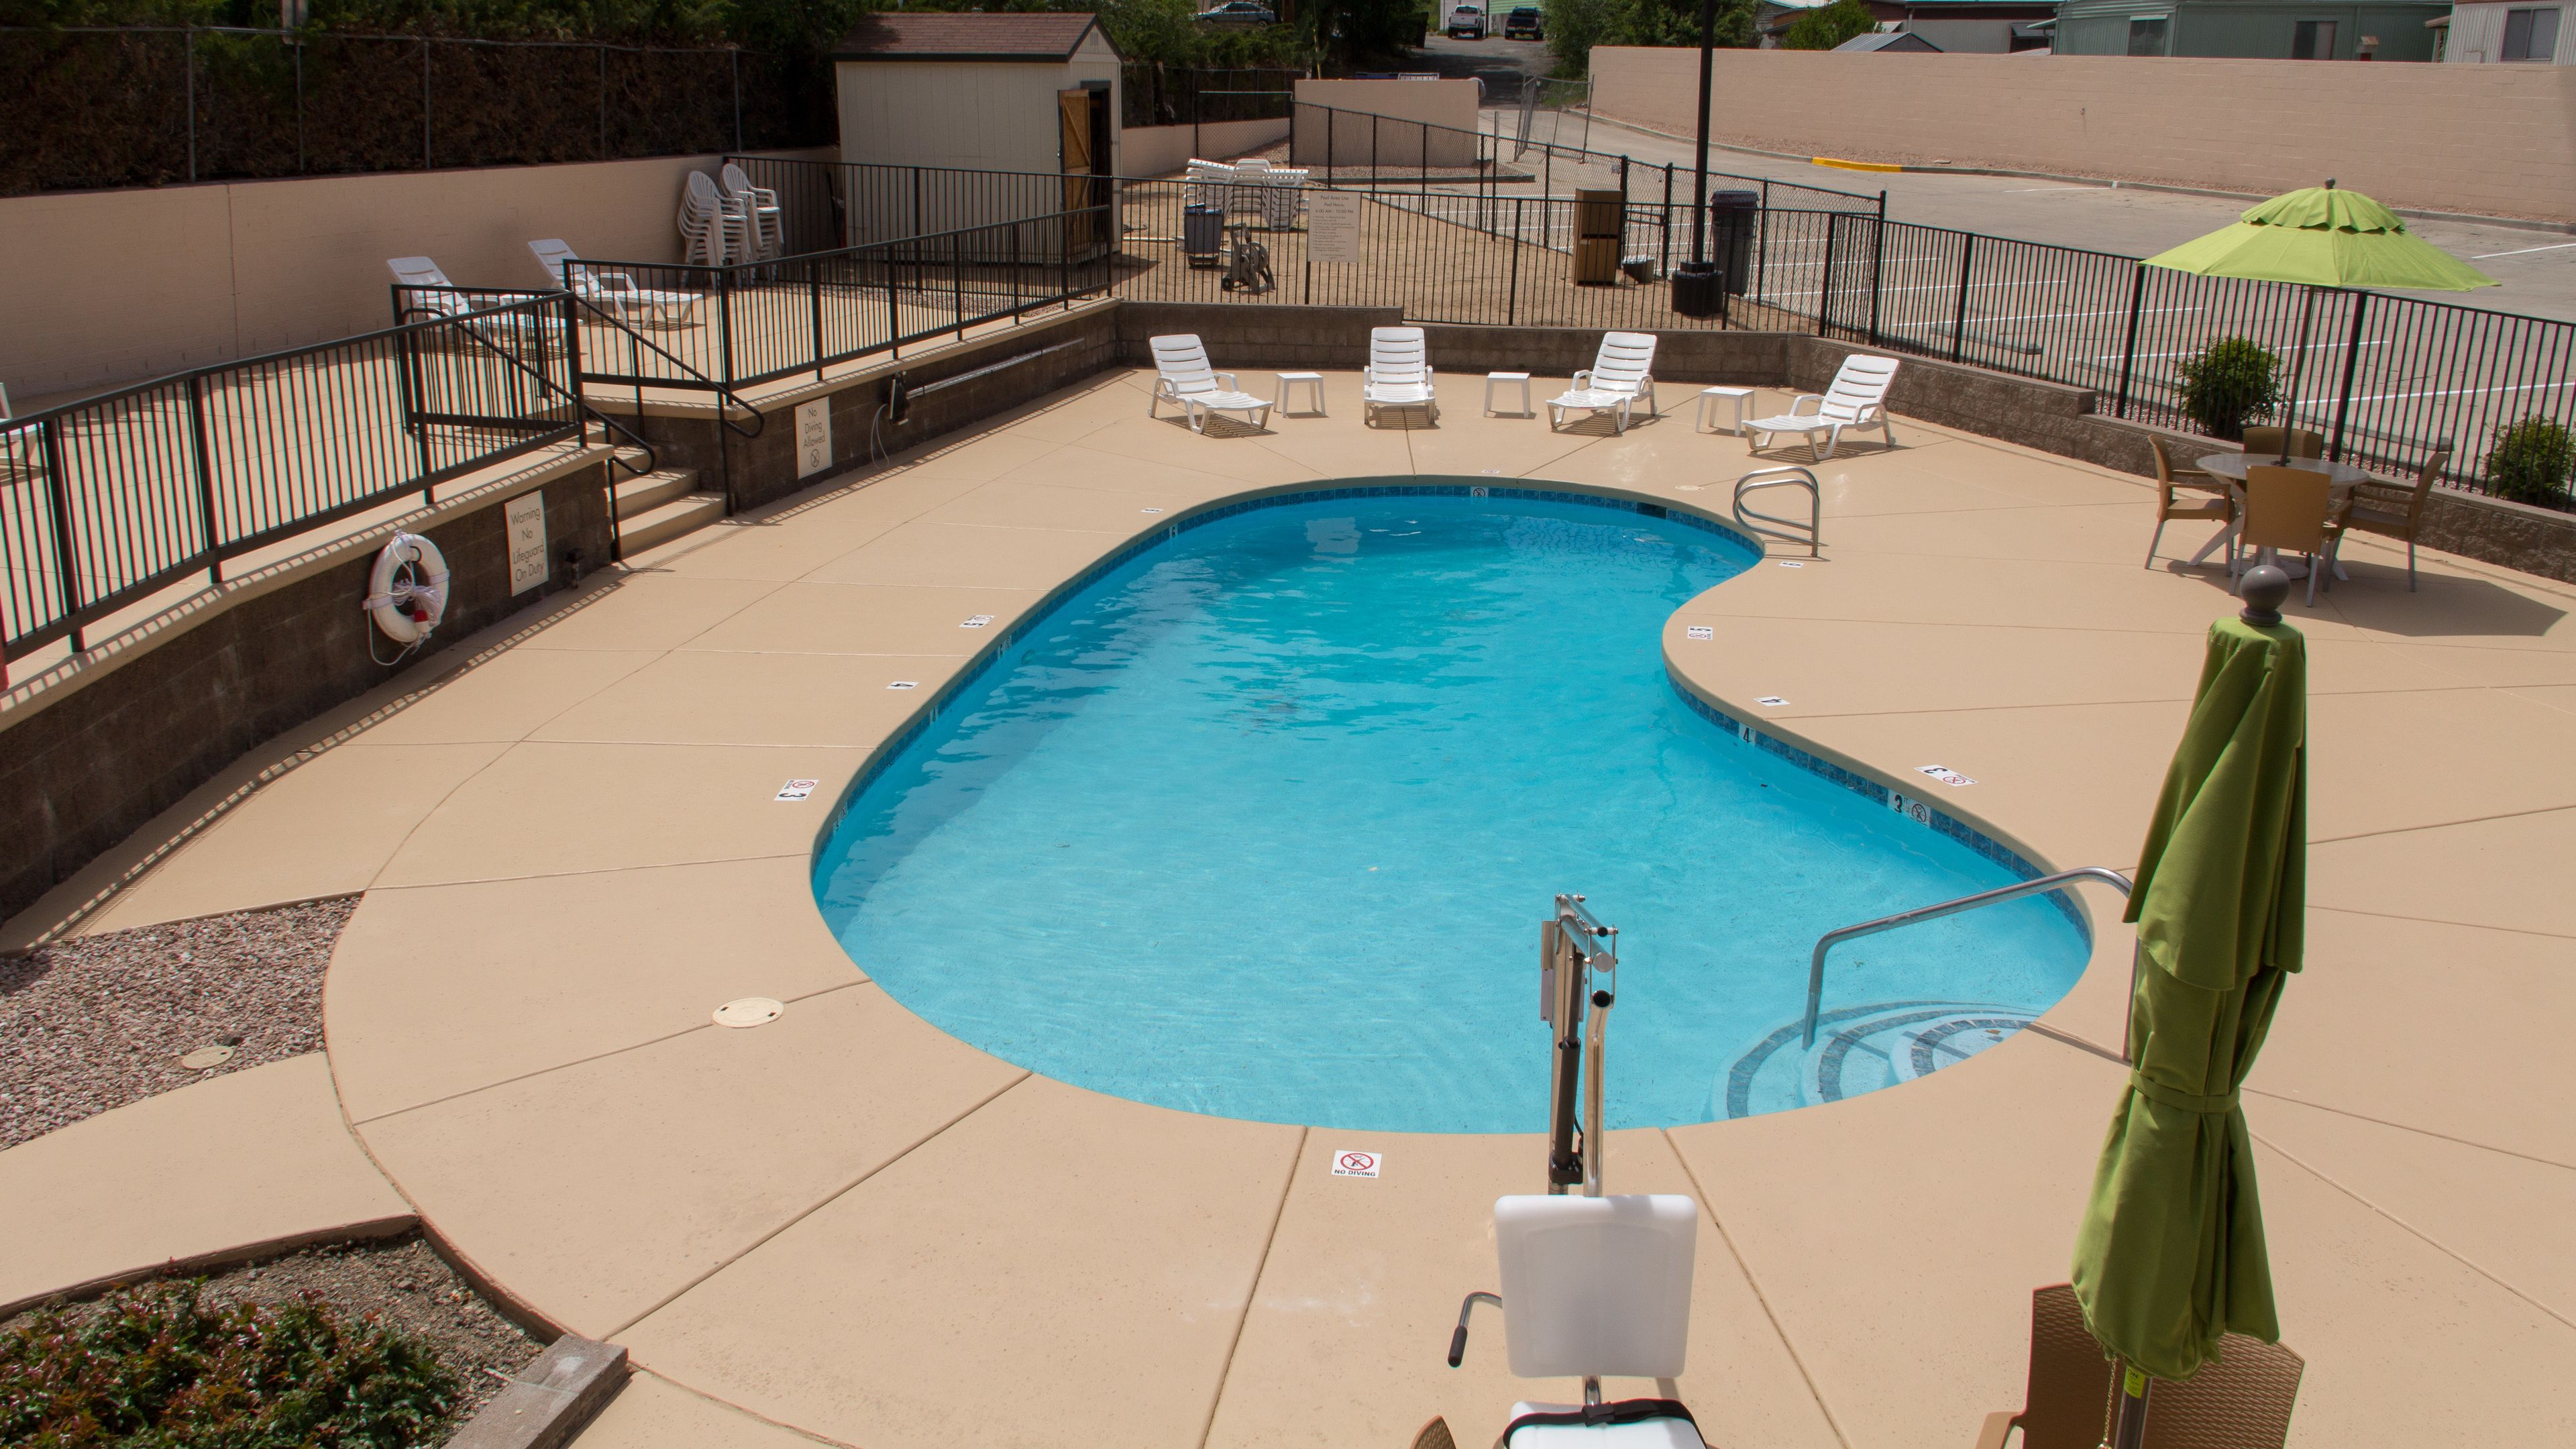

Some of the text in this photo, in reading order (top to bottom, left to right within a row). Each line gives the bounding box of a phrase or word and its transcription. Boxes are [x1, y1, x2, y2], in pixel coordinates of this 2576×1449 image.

[808, 408, 817, 419] No
[805, 421, 822, 434] Diving
[804, 431, 826, 449] Allowed
[511, 507, 541, 525] Warning
[522, 529, 533, 542] No
[513, 538, 545, 564] Lifeguard
[516, 561, 545, 582] On Duty
[1743, 727, 1752, 743] 4
[1894, 794, 1902, 813] 3
